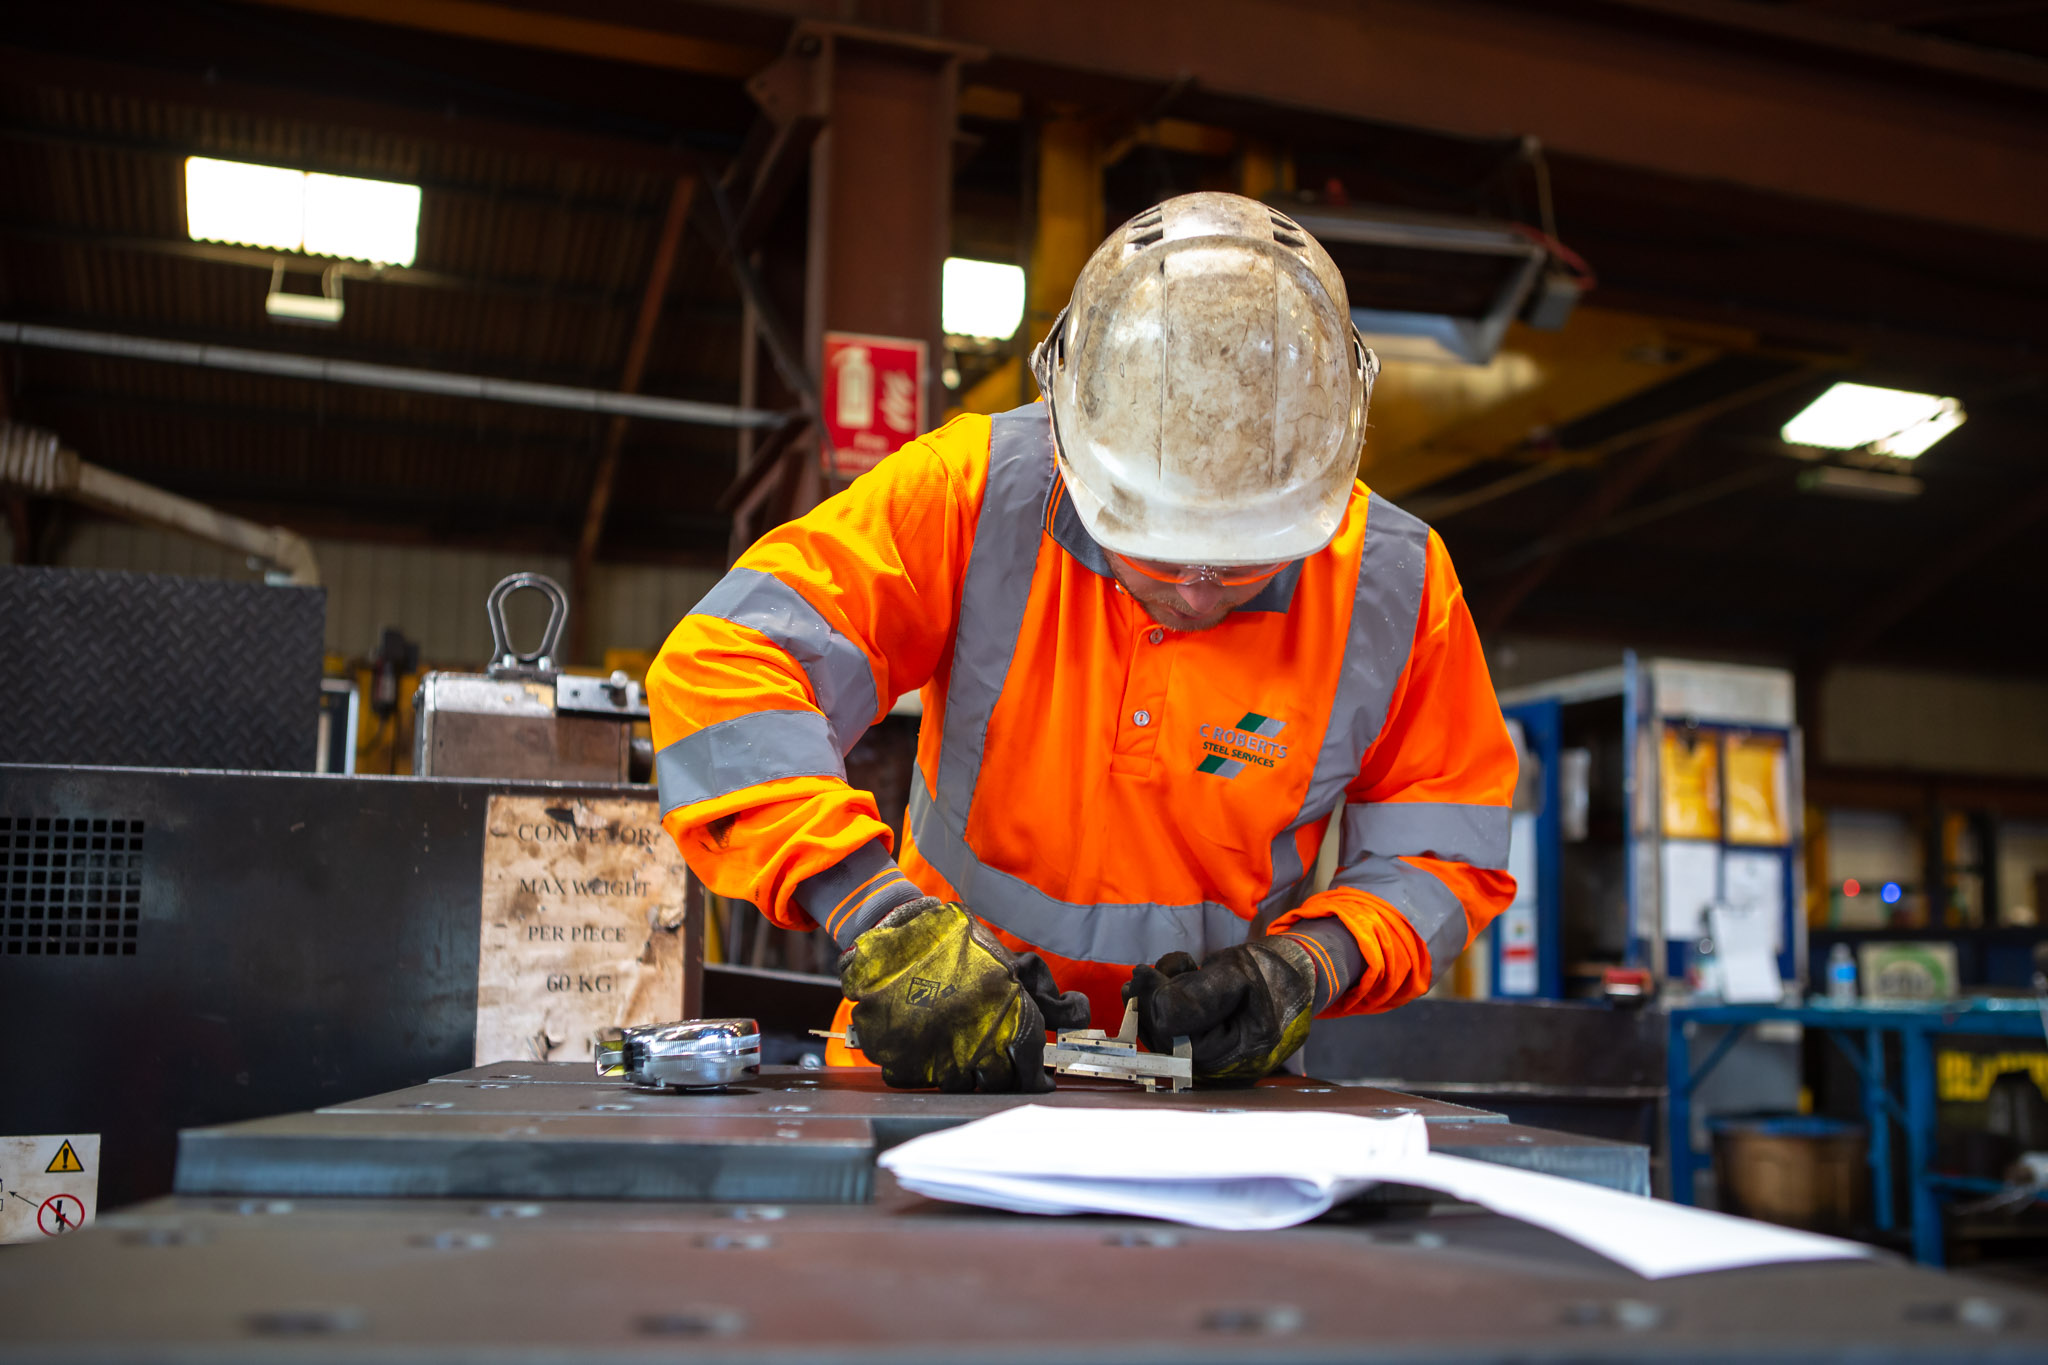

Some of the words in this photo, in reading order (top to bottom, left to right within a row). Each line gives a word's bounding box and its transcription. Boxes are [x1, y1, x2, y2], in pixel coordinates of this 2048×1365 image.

[1199, 723, 1210, 738] C
[1212, 726, 1288, 758] ROBERTS
[1203, 741, 1229, 756] STEEL
[1231, 749, 1275, 768] SERVICES
[518, 823, 651, 847] CONVEOR
[520, 878, 566, 895] MAX
[528, 925, 565, 942] PER
[571, 926, 627, 943] PIECE
[546, 975, 571, 993] 60
[579, 975, 612, 993] KG
